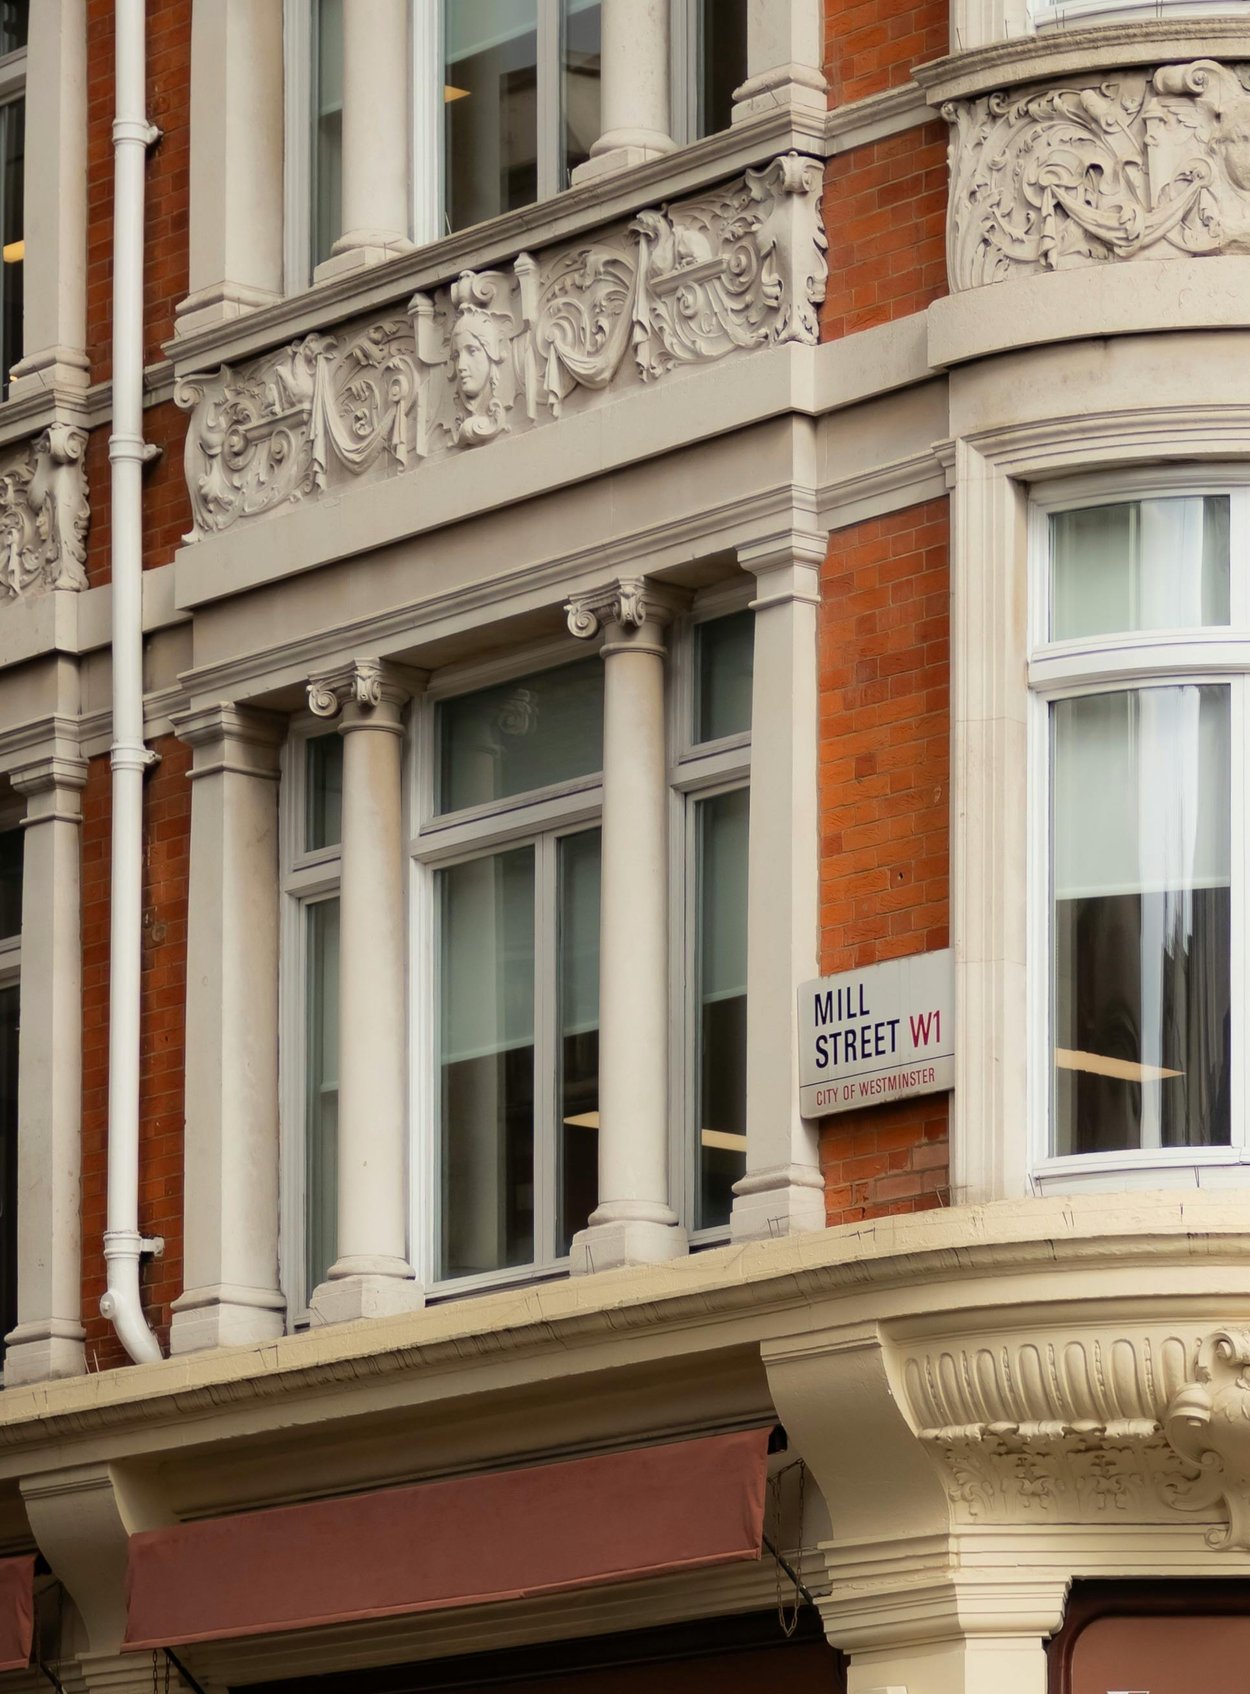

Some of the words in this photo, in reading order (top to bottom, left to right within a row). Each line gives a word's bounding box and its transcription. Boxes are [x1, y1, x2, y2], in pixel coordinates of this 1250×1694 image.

[814, 983, 870, 1027] MILL
[815, 1018, 900, 1069] STREET
[909, 1010, 941, 1048] W1
[816, 1087, 839, 1106] CITY
[843, 1083, 856, 1101] OF
[859, 1067, 936, 1097] WESTMINSTER
